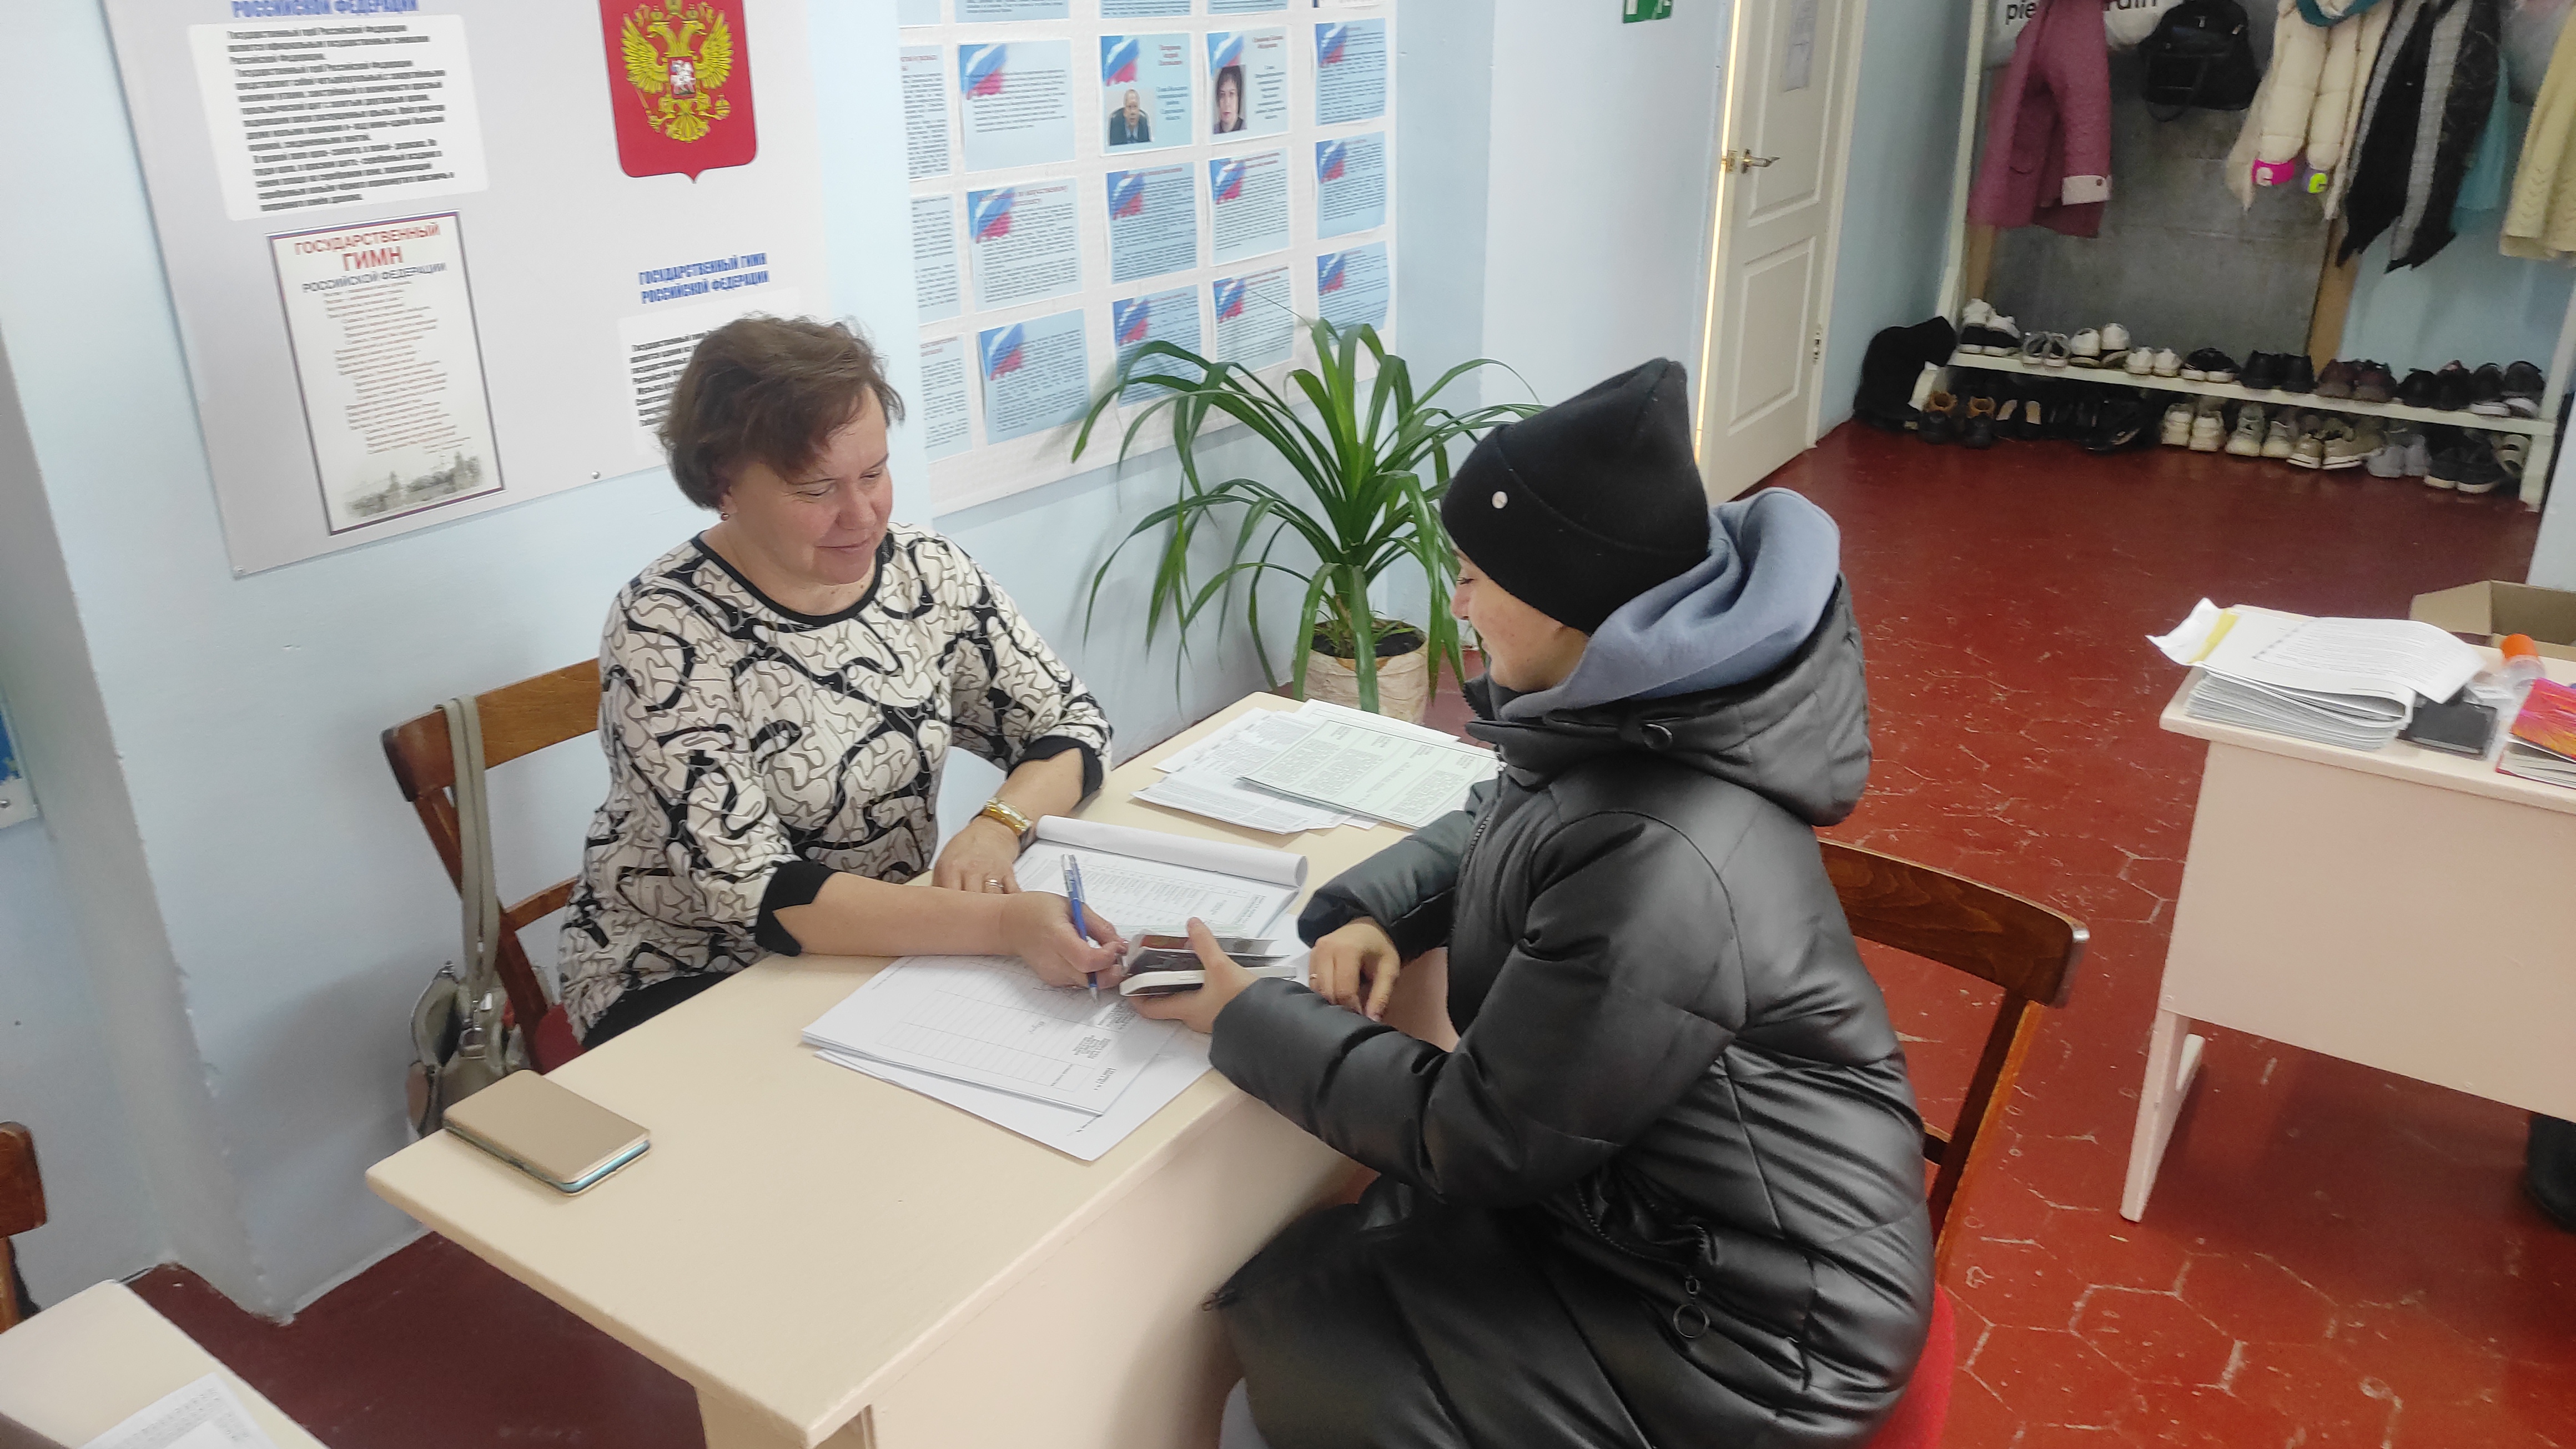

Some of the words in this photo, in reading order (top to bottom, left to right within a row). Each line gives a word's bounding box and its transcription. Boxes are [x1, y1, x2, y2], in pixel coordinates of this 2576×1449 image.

[294, 222, 441, 255] ГОСУДАРСТВЕННЫЙ
[342, 246, 404, 271] ГИМН
[638, 255, 738, 285] ГОСУДАРСТВЕННЫЙ
[740, 253, 767, 267] ГИМН
[302, 271, 379, 293] РОССИЙСКОЙ
[381, 262, 447, 280] ФЕДЕРАЦИИ
[641, 279, 710, 304] РОССИЙСКОЙ
[711, 270, 770, 291] ФЕДЕРАЦИИ
